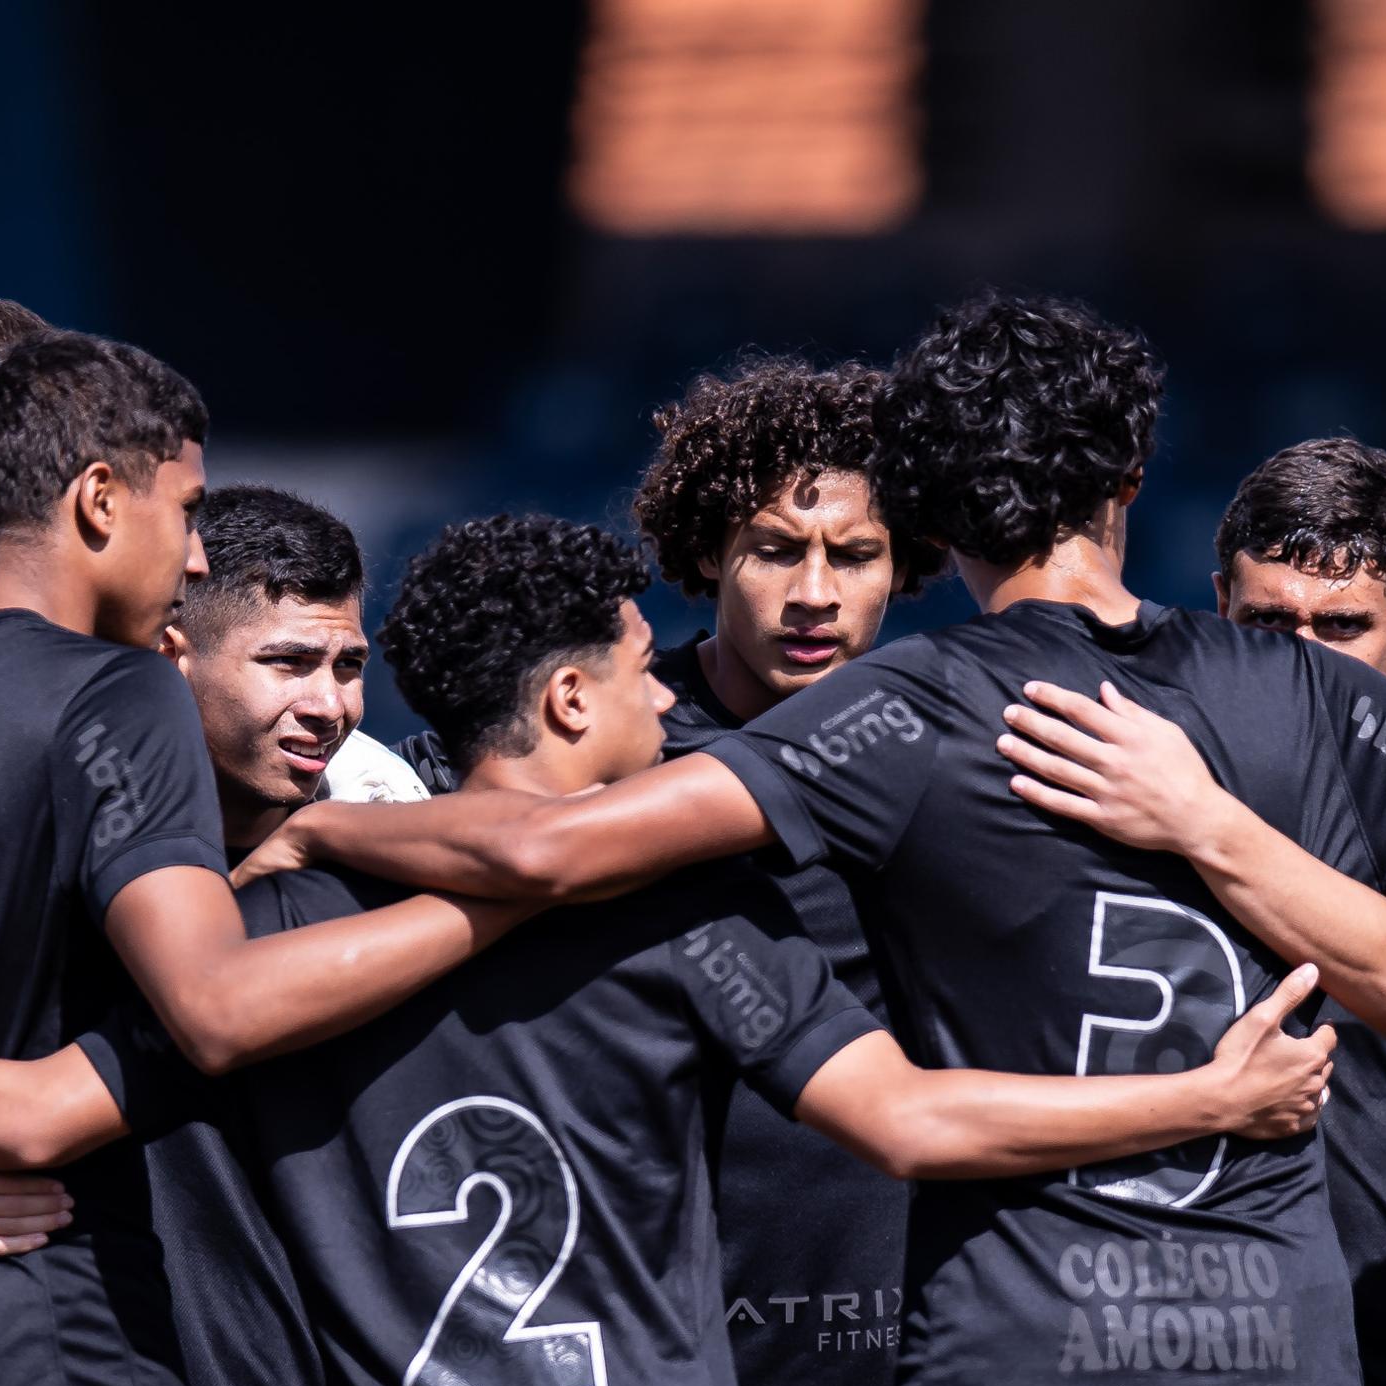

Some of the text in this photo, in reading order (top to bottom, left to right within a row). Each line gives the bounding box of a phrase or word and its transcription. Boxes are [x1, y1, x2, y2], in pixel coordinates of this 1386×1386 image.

[808, 695, 924, 767] bmg
[698, 940, 784, 1048] bmg
[1059, 1230, 1279, 1299] COLÉGIO
[1059, 1304, 1296, 1374] AMORIM
